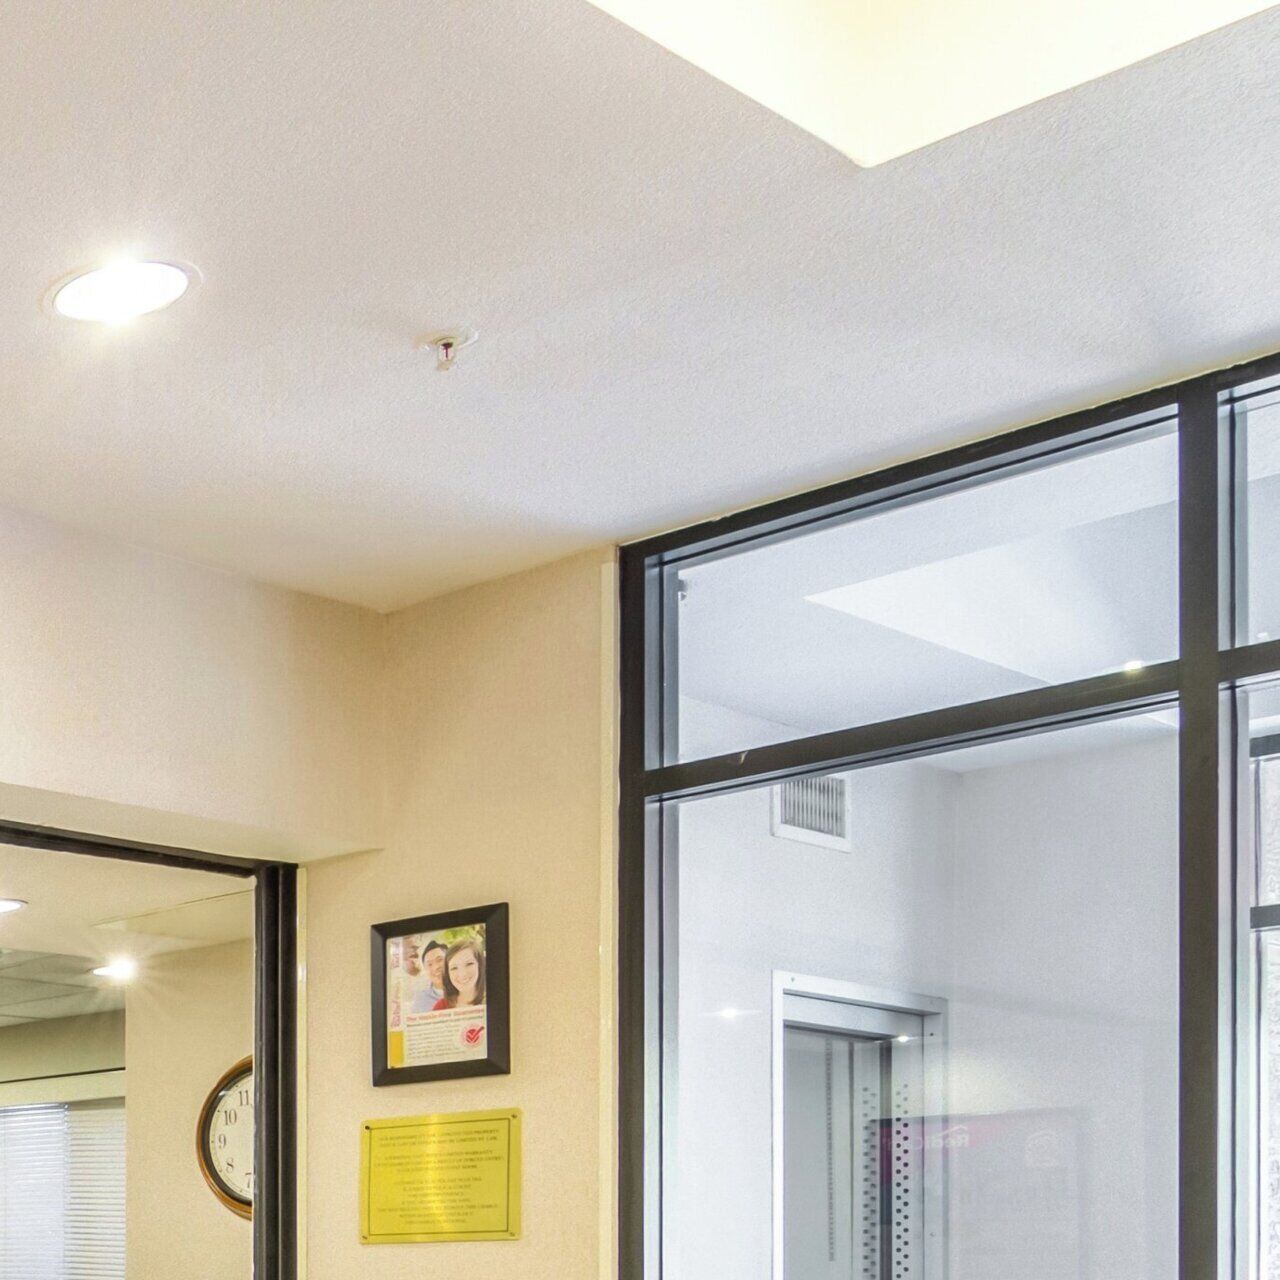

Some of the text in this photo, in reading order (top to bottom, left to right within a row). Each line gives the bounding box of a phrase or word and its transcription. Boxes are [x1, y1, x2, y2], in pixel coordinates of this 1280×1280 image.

[238, 1090, 249, 1107] 11
[224, 1109, 237, 1126] 10
[218, 1134, 227, 1149] 9
[225, 1158, 234, 1173] 8
